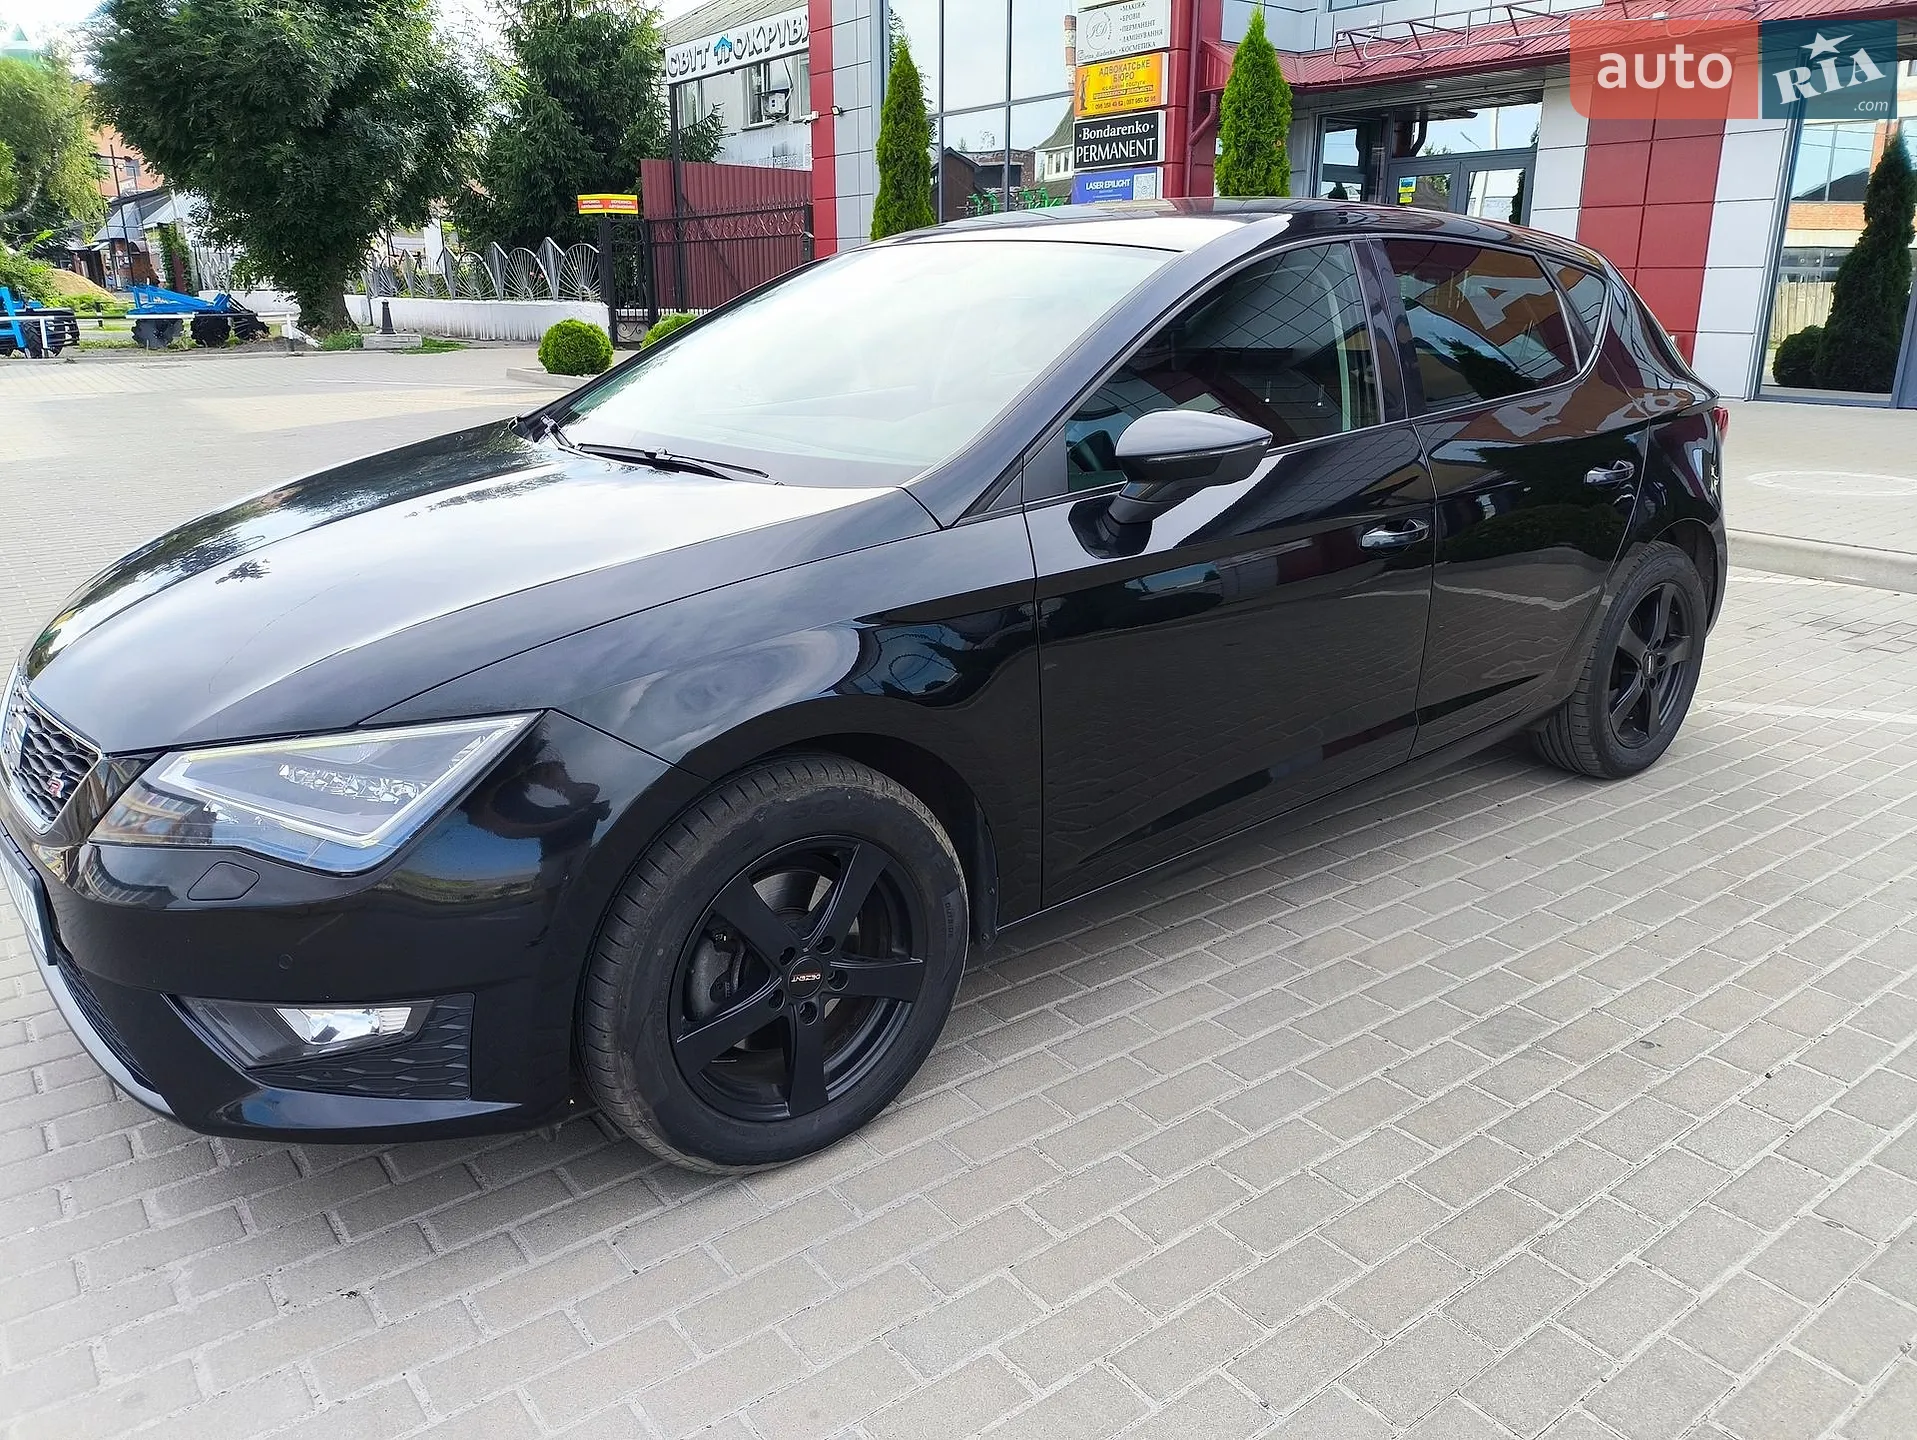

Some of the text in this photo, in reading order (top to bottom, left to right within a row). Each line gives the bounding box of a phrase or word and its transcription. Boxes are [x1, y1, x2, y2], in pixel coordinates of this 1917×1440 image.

[668, 41, 711, 77] СВІТ
[1099, 59, 1151, 76] АДВОКАТСЬКЕ
[1113, 71, 1135, 83] БЮРО
[1076, 138, 1156, 163] PERMANENT
[1085, 179, 1131, 190] LASER EPILIGHT
